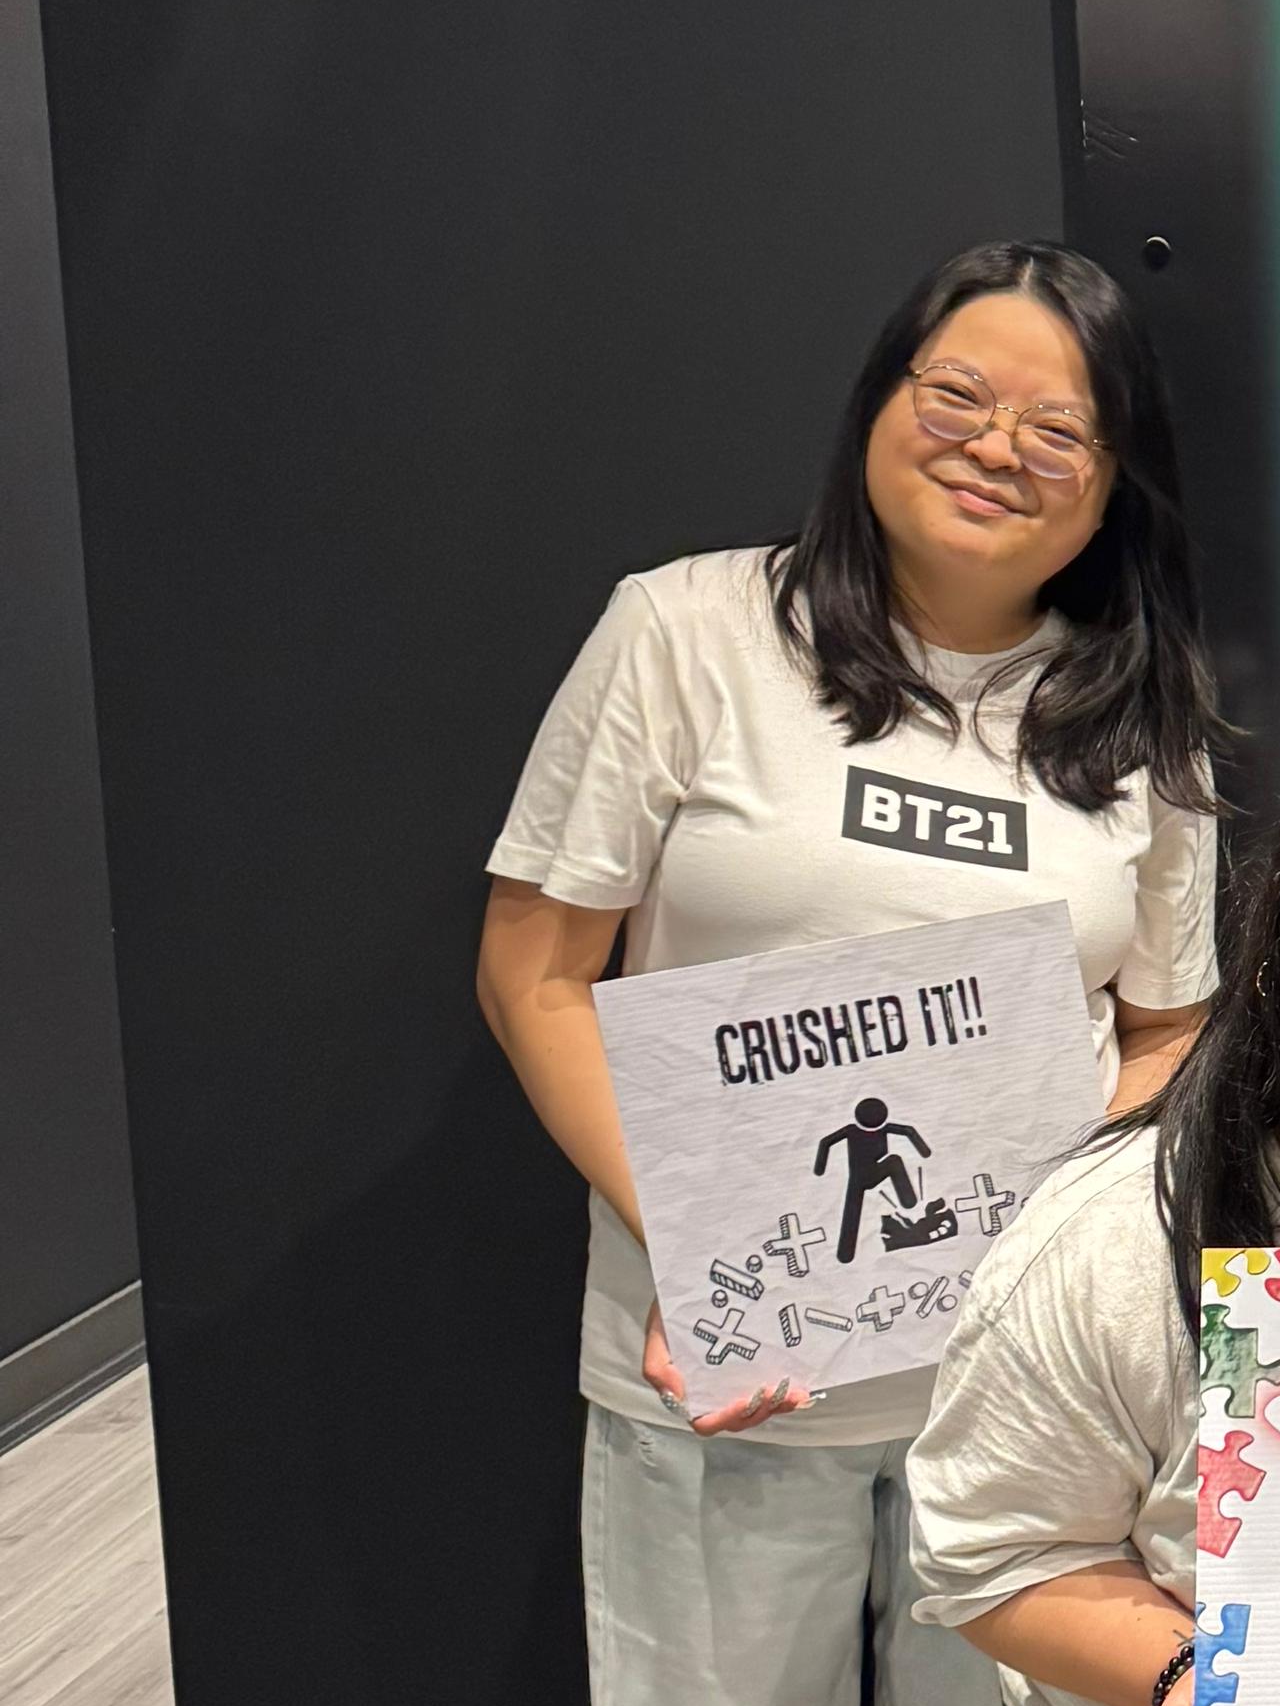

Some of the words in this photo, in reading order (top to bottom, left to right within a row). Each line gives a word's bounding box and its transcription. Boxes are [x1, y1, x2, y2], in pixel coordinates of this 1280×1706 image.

[861, 783, 1013, 855] BT21
[715, 994, 908, 1086] CRUSHED
[919, 976, 987, 1047] IT!!
